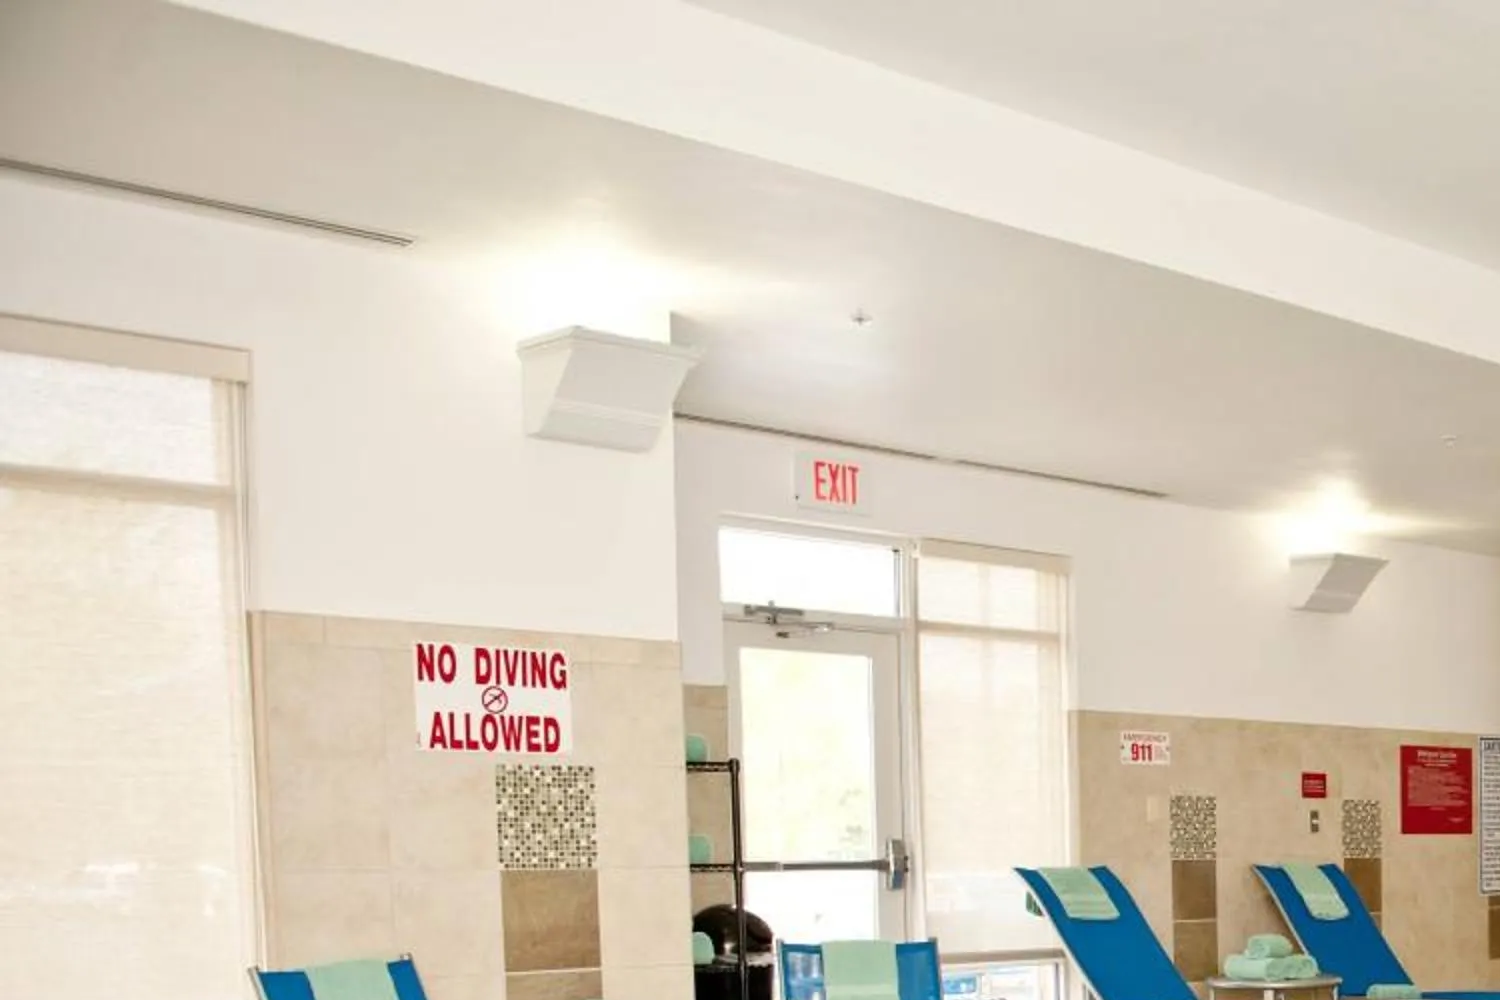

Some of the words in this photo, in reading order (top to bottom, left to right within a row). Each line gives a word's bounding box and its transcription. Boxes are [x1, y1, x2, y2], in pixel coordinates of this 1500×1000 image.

[814, 461, 859, 504] EXIT
[417, 643, 457, 683] NO
[475, 647, 567, 690] DIVING
[430, 711, 561, 752] ALLOWED
[1131, 743, 1153, 762] 911
